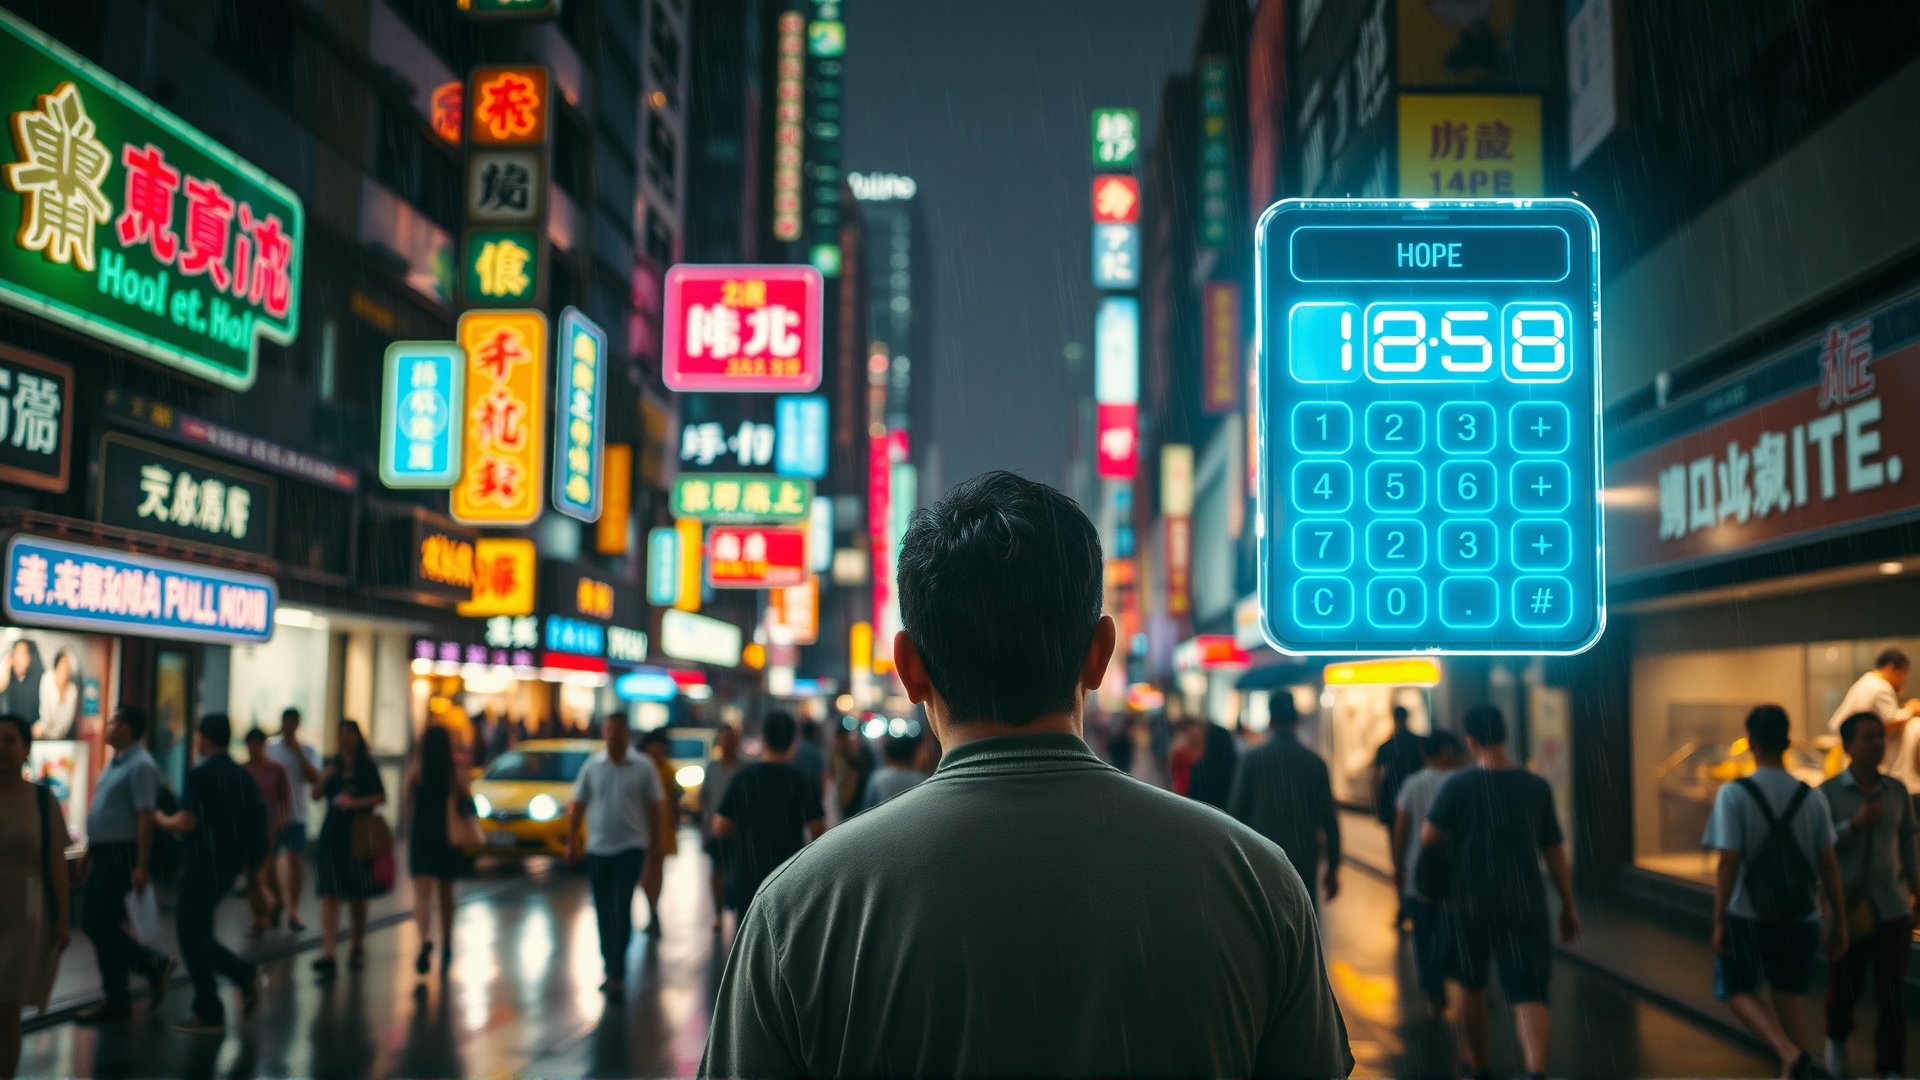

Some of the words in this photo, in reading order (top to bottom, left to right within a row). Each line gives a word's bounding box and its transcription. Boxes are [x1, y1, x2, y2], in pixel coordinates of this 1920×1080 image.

[1397, 242, 1463, 268] HOPE
[98, 247, 169, 317] Hool
[1316, 413, 1328, 441] 1
[1385, 413, 1403, 441] 2
[1458, 413, 1476, 441] 3
[1313, 472, 1333, 500] 4
[1386, 472, 1405, 500] 5
[1458, 472, 1477, 500] 6
[1314, 531, 1333, 558] 7
[1386, 531, 1406, 559] 2
[1459, 531, 1478, 559] 3
[164, 576, 218, 626] PULL
[1312, 587, 1334, 616] C
[1386, 587, 1406, 616] 0
[1531, 587, 1553, 614] #
